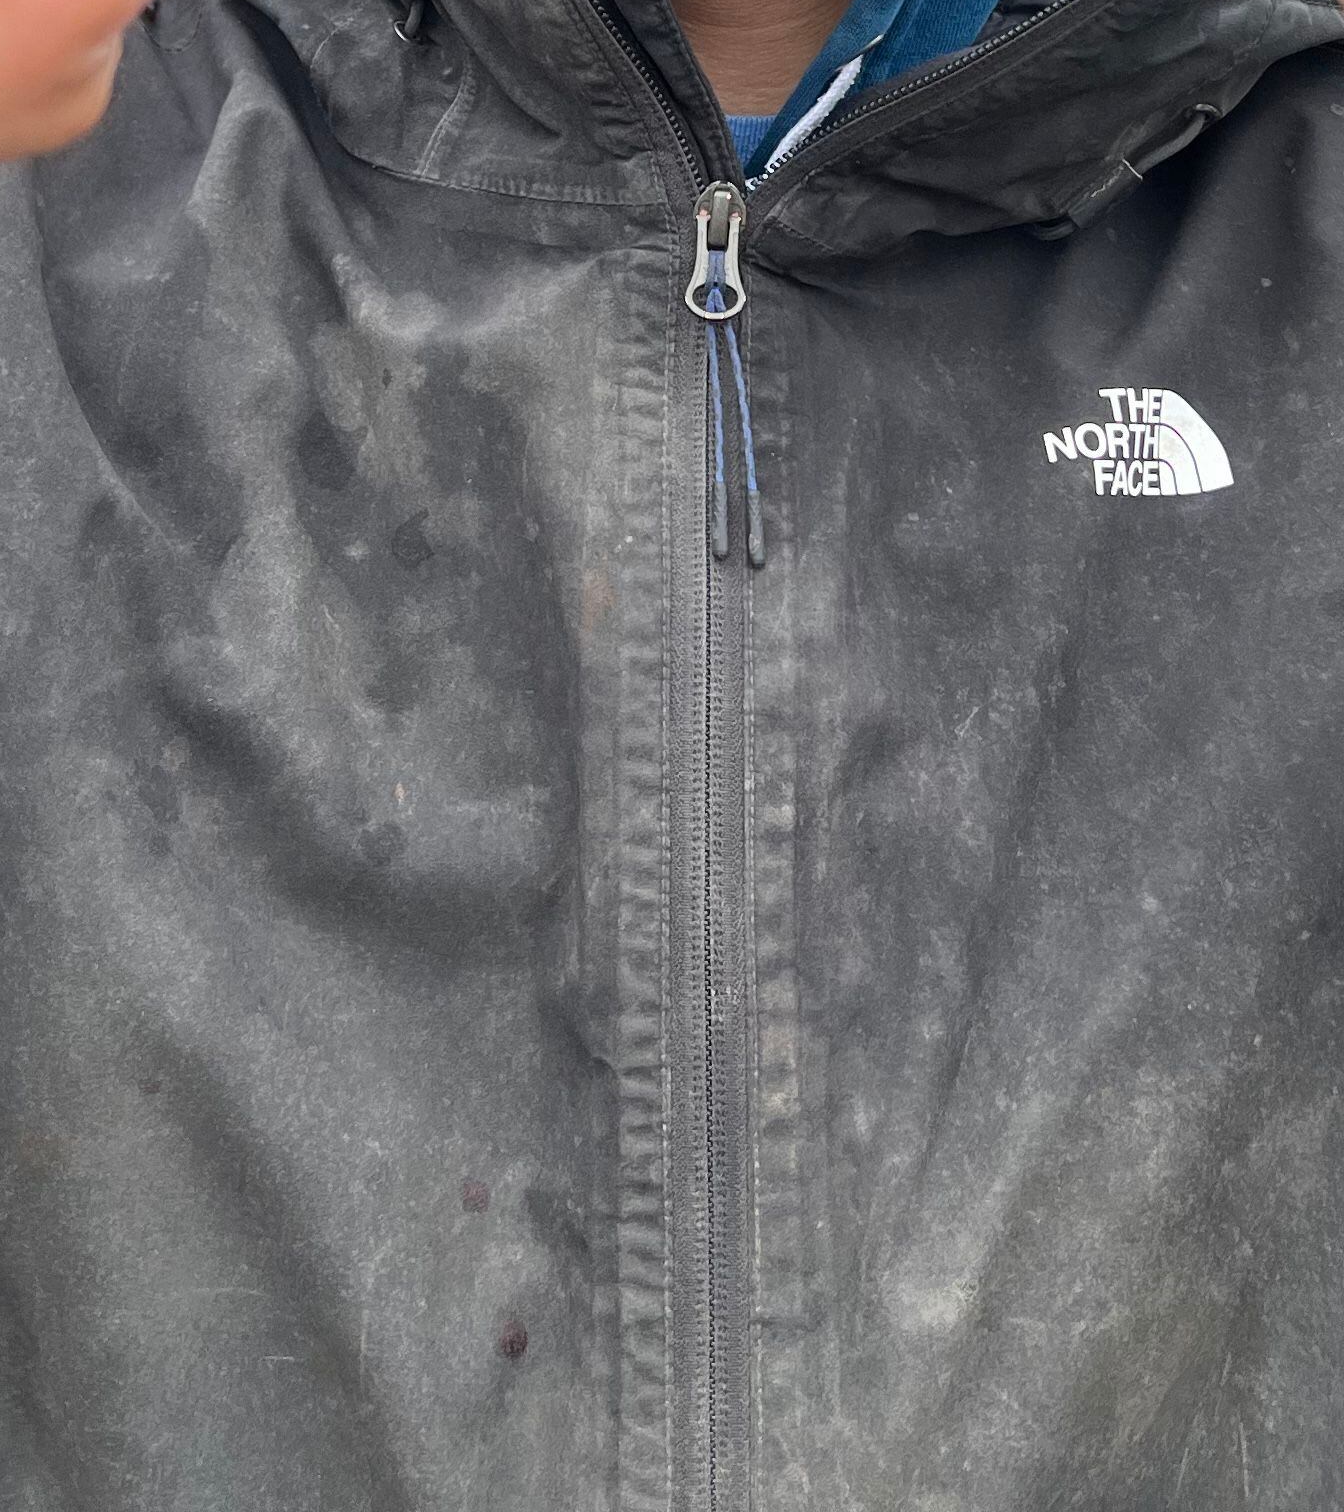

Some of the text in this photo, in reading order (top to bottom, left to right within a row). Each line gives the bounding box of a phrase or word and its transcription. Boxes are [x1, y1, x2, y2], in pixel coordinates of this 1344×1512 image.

[1098, 387, 1163, 423] THE
[1043, 422, 1160, 463] NORTH
[1093, 460, 1161, 497] FACE
